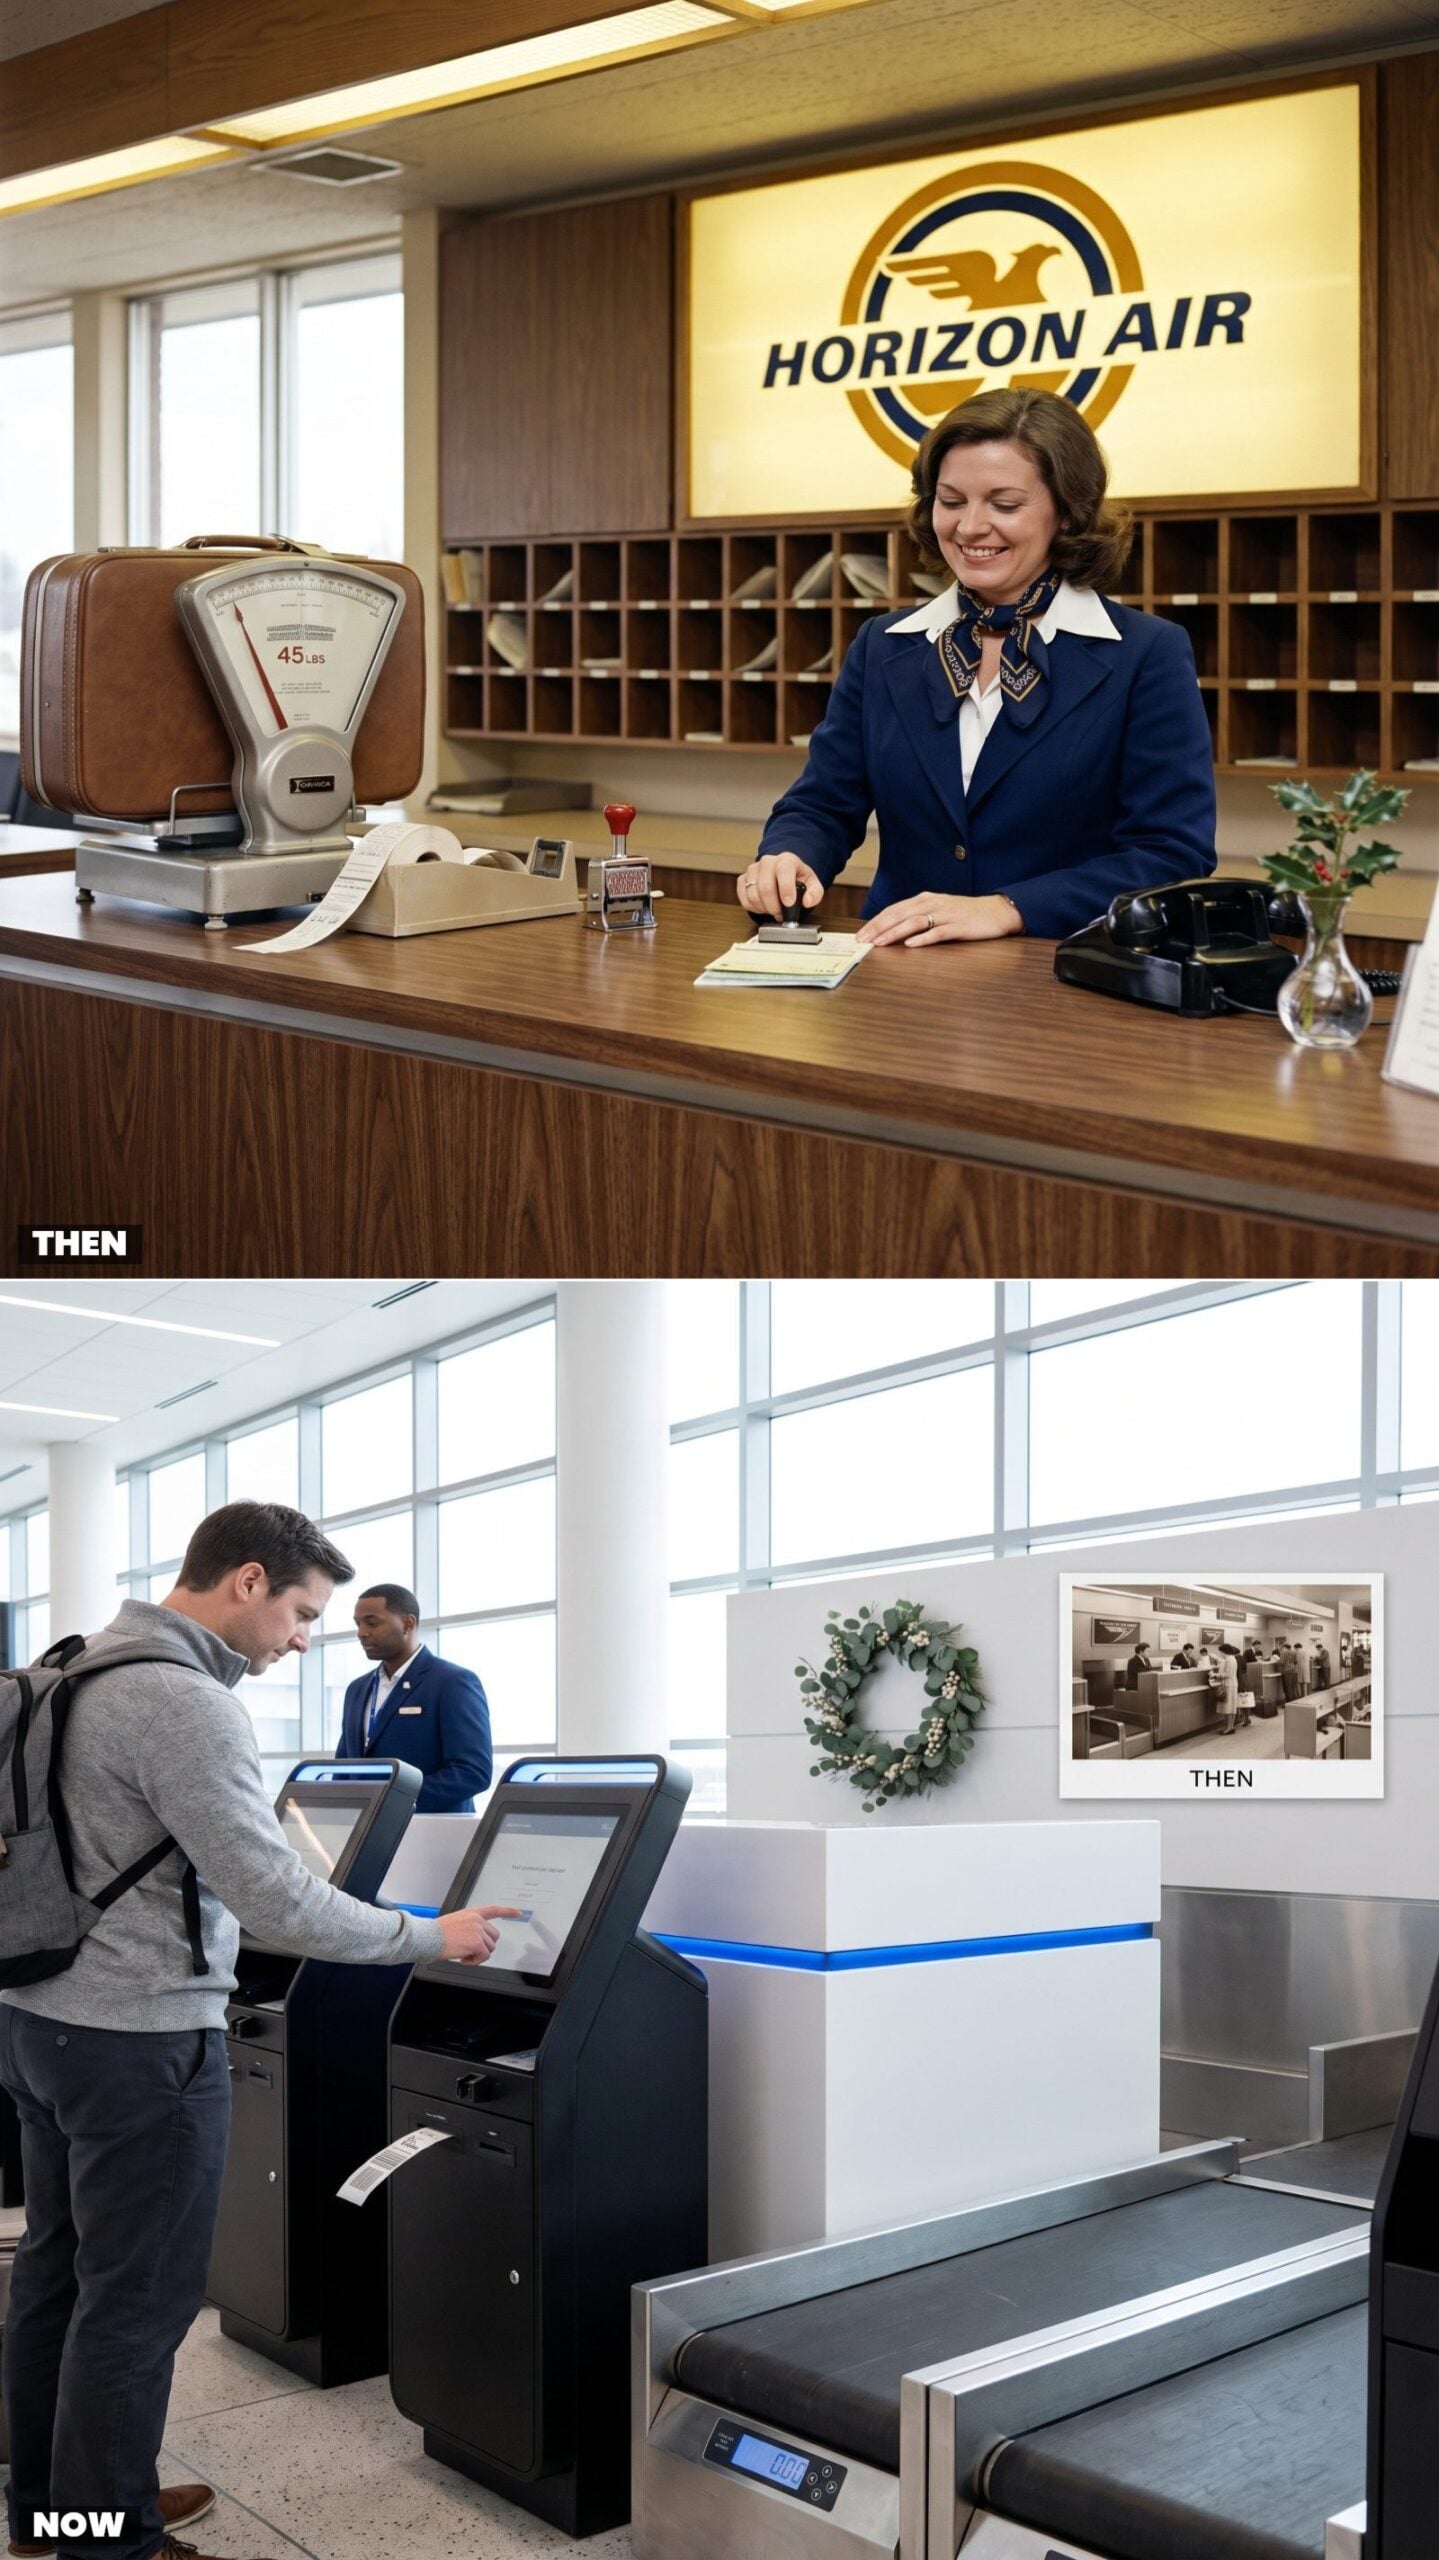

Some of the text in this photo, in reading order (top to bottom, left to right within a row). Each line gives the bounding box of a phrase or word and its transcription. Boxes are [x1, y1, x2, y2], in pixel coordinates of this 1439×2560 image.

[762, 291, 1252, 388] HORIZON AIR
[277, 646, 325, 664] 45 LBS
[1189, 1770, 1253, 1787] THEN
[769, 2453, 808, 2484] 0.00
